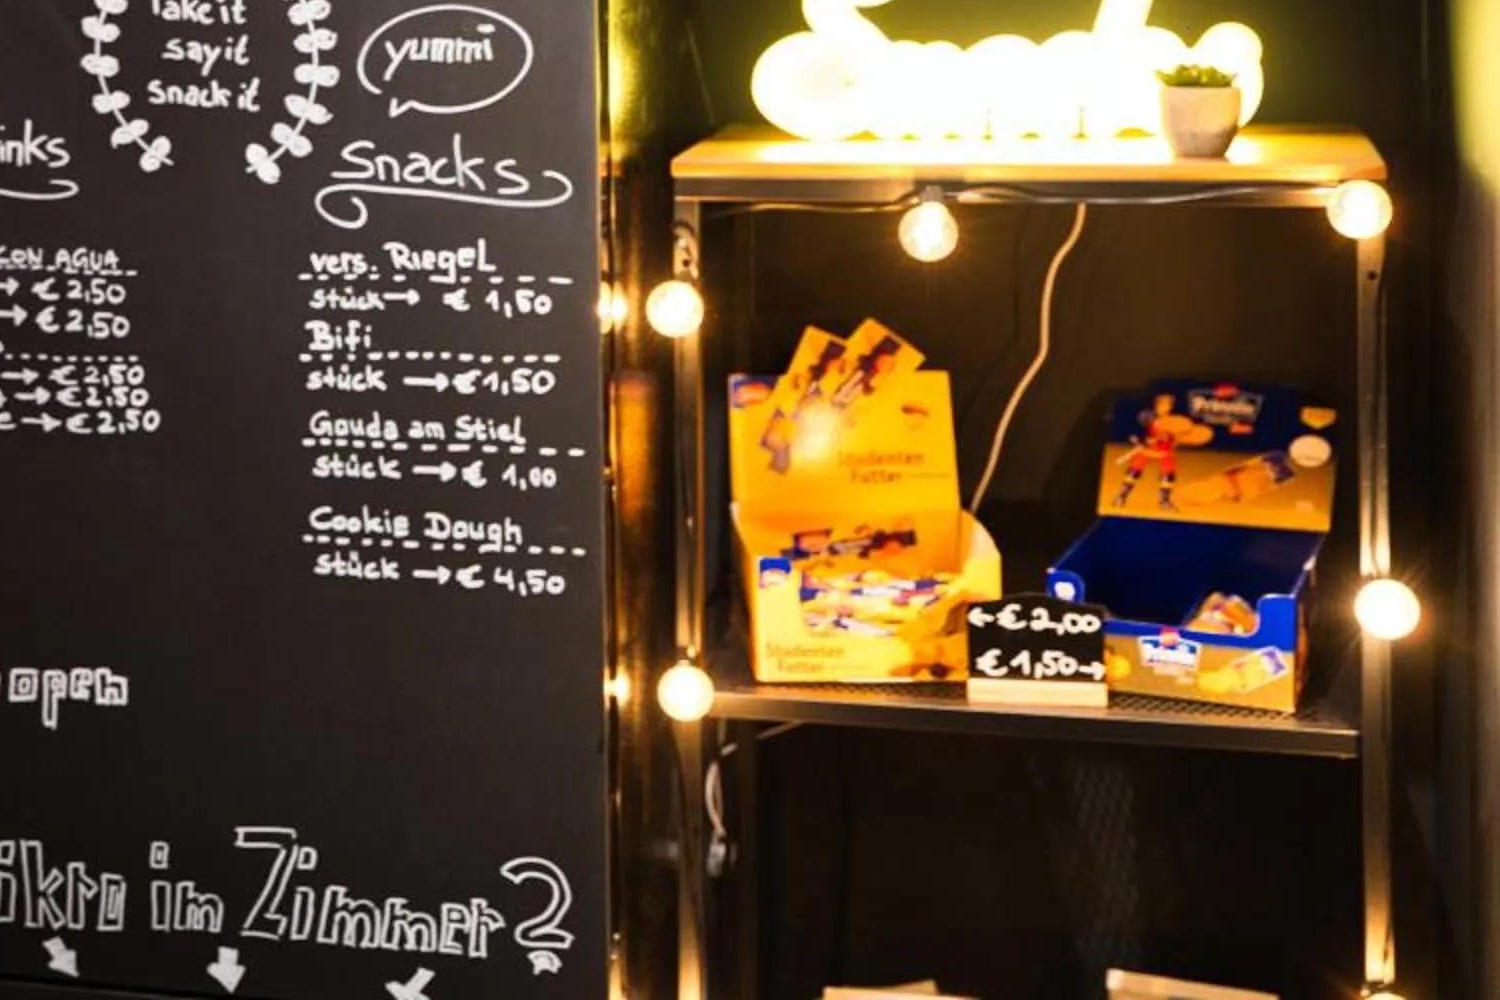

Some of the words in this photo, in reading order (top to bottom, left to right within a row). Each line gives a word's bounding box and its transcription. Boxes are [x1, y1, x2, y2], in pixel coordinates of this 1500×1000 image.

[382, 22, 496, 82] yummi
[146, 78, 233, 110] Snack
[236, 76, 262, 113] it
[331, 134, 530, 196] Snacks
[54, 248, 120, 272] AGUA
[308, 409, 399, 441] Gouda
[407, 418, 446, 440] am
[454, 414, 527, 446] Stiel
[308, 504, 411, 538] Cookie
[423, 511, 523, 553] Dough
[8, 667, 129, 730] open
[234, 826, 505, 958] Zimmer
